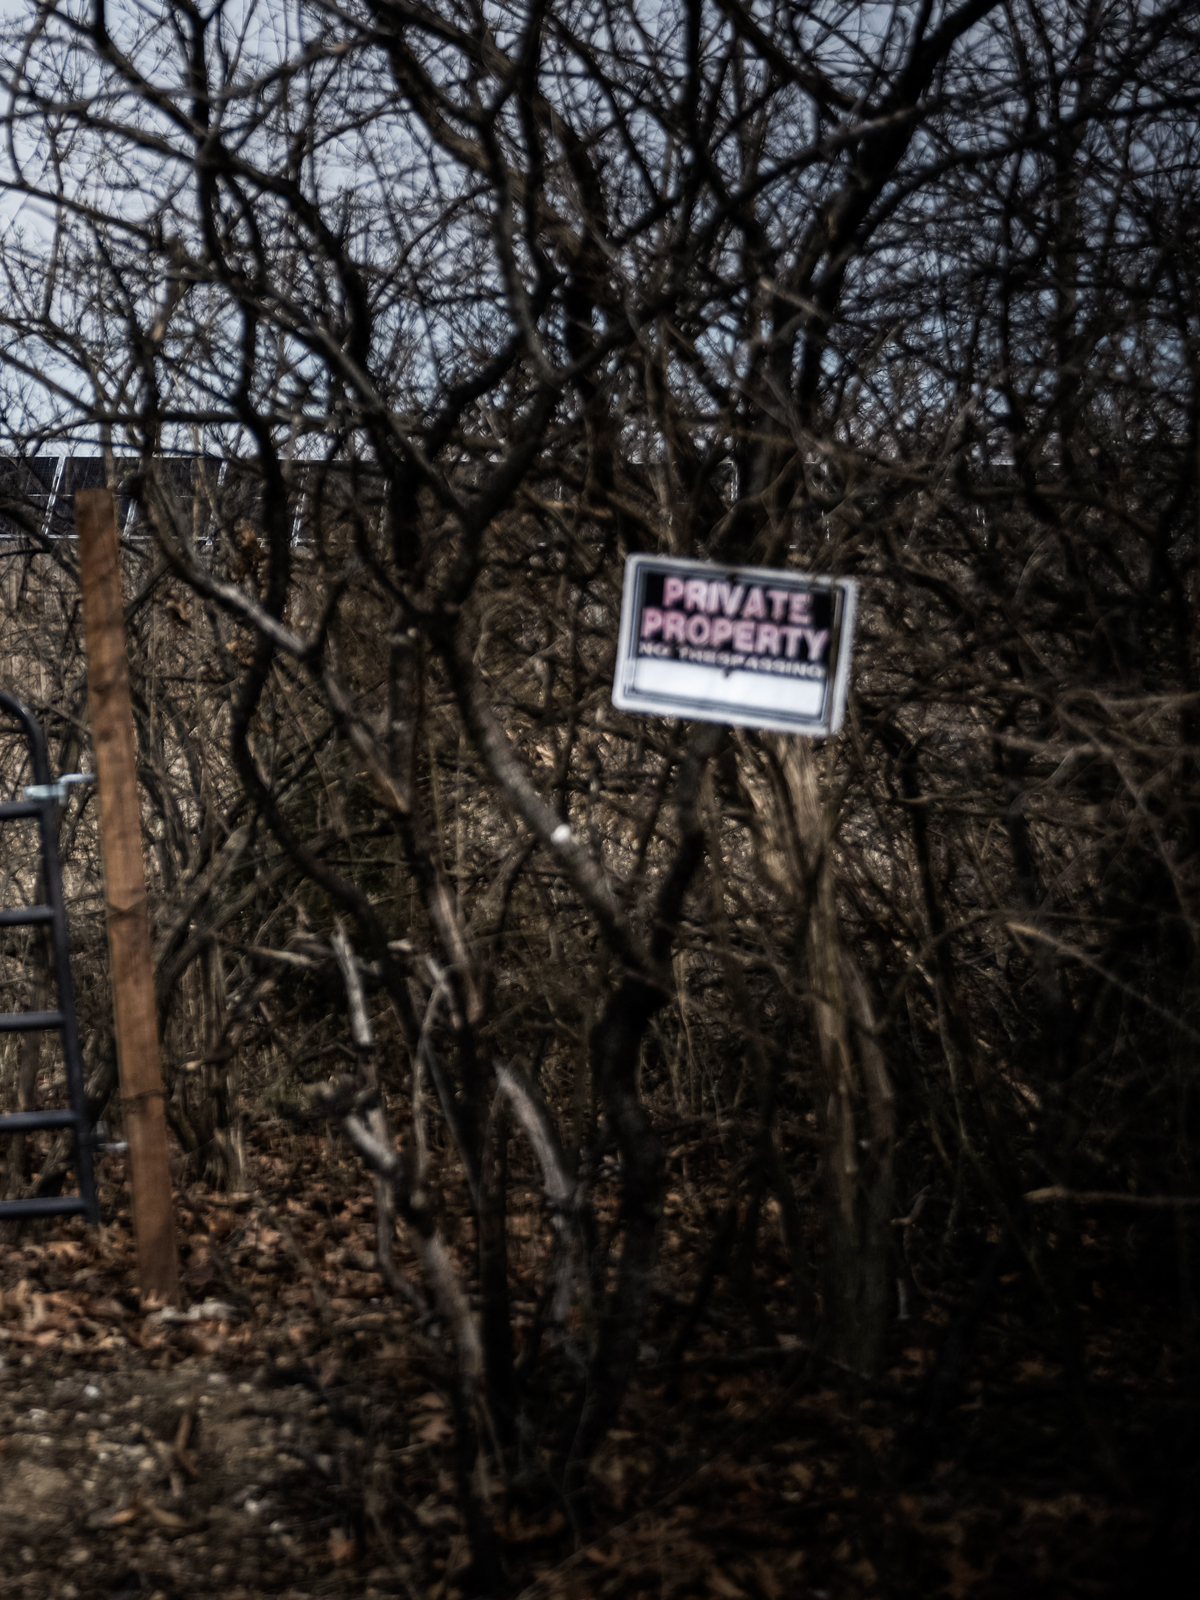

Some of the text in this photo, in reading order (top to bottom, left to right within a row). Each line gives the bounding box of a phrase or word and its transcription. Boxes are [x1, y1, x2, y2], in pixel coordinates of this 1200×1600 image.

[662, 576, 811, 625] PRIVATE
[642, 607, 829, 661] PROPERTY
[677, 647, 826, 679] TRESPASSING
